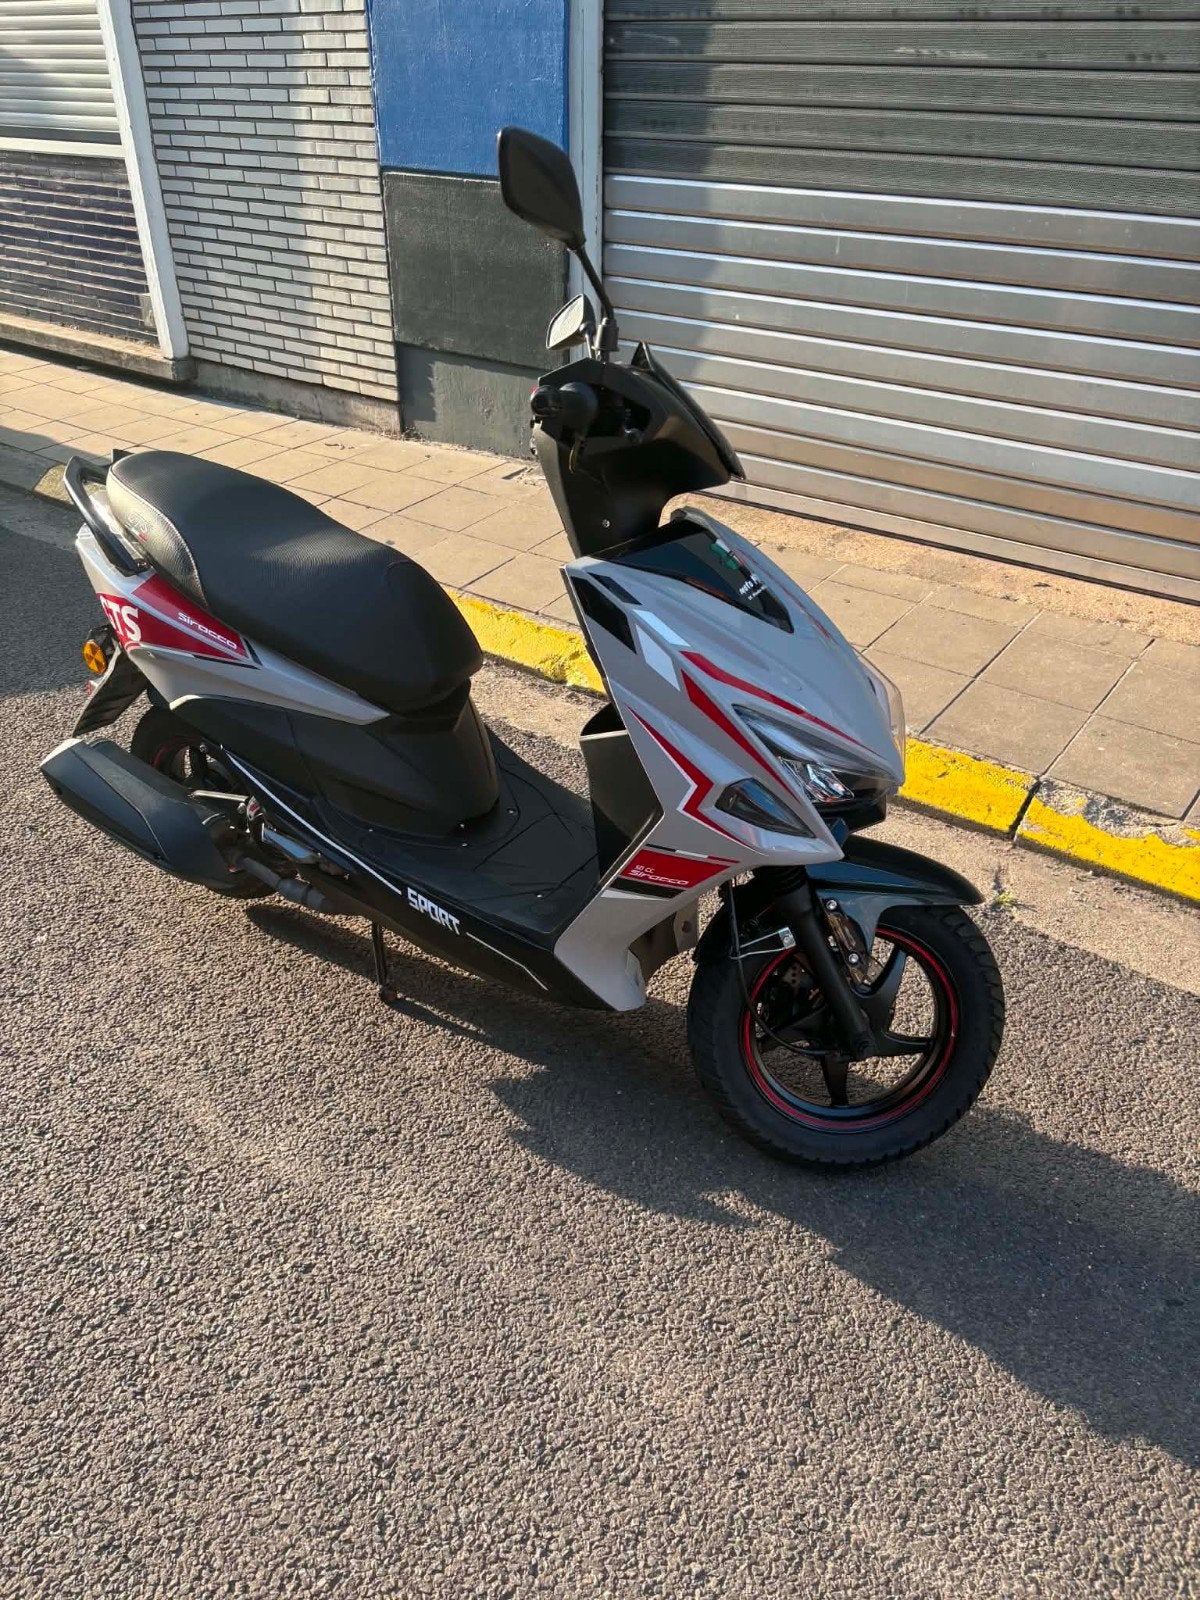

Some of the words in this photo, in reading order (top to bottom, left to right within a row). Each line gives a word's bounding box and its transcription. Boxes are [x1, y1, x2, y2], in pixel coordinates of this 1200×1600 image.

[177, 612, 238, 650] Sirocco
[628, 869, 689, 885] Sirocco
[407, 886, 460, 935] SPORT
